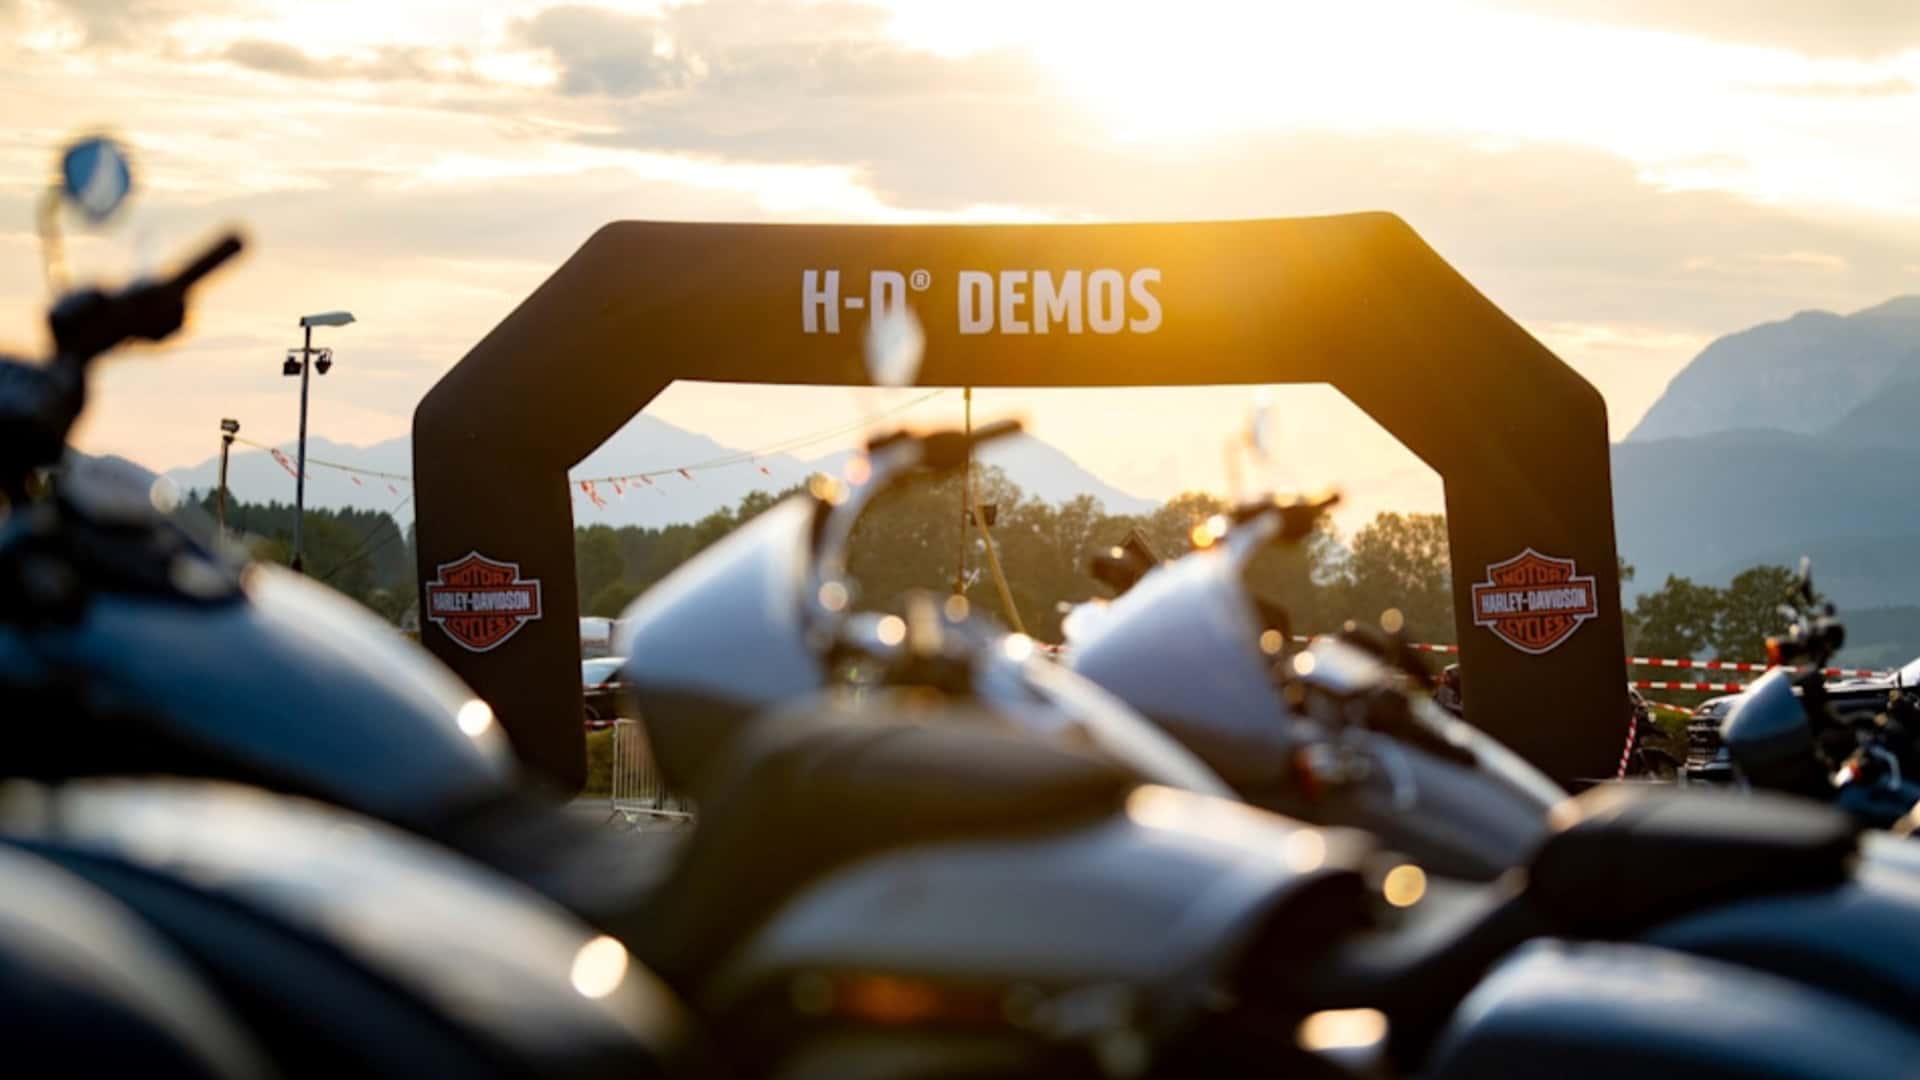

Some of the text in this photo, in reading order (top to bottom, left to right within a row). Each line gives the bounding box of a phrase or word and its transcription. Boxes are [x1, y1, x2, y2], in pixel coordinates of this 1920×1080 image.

[957, 269, 1163, 334] DEMOS
[444, 566, 513, 585] MOTOR
[1494, 564, 1571, 585] MOTOR
[433, 590, 530, 611] HARLEY-DAVIDSON
[1481, 587, 1587, 613] HARLEY-DAVIDSON
[447, 617, 515, 640] CYCLES
[1500, 616, 1574, 642] CYCLES
